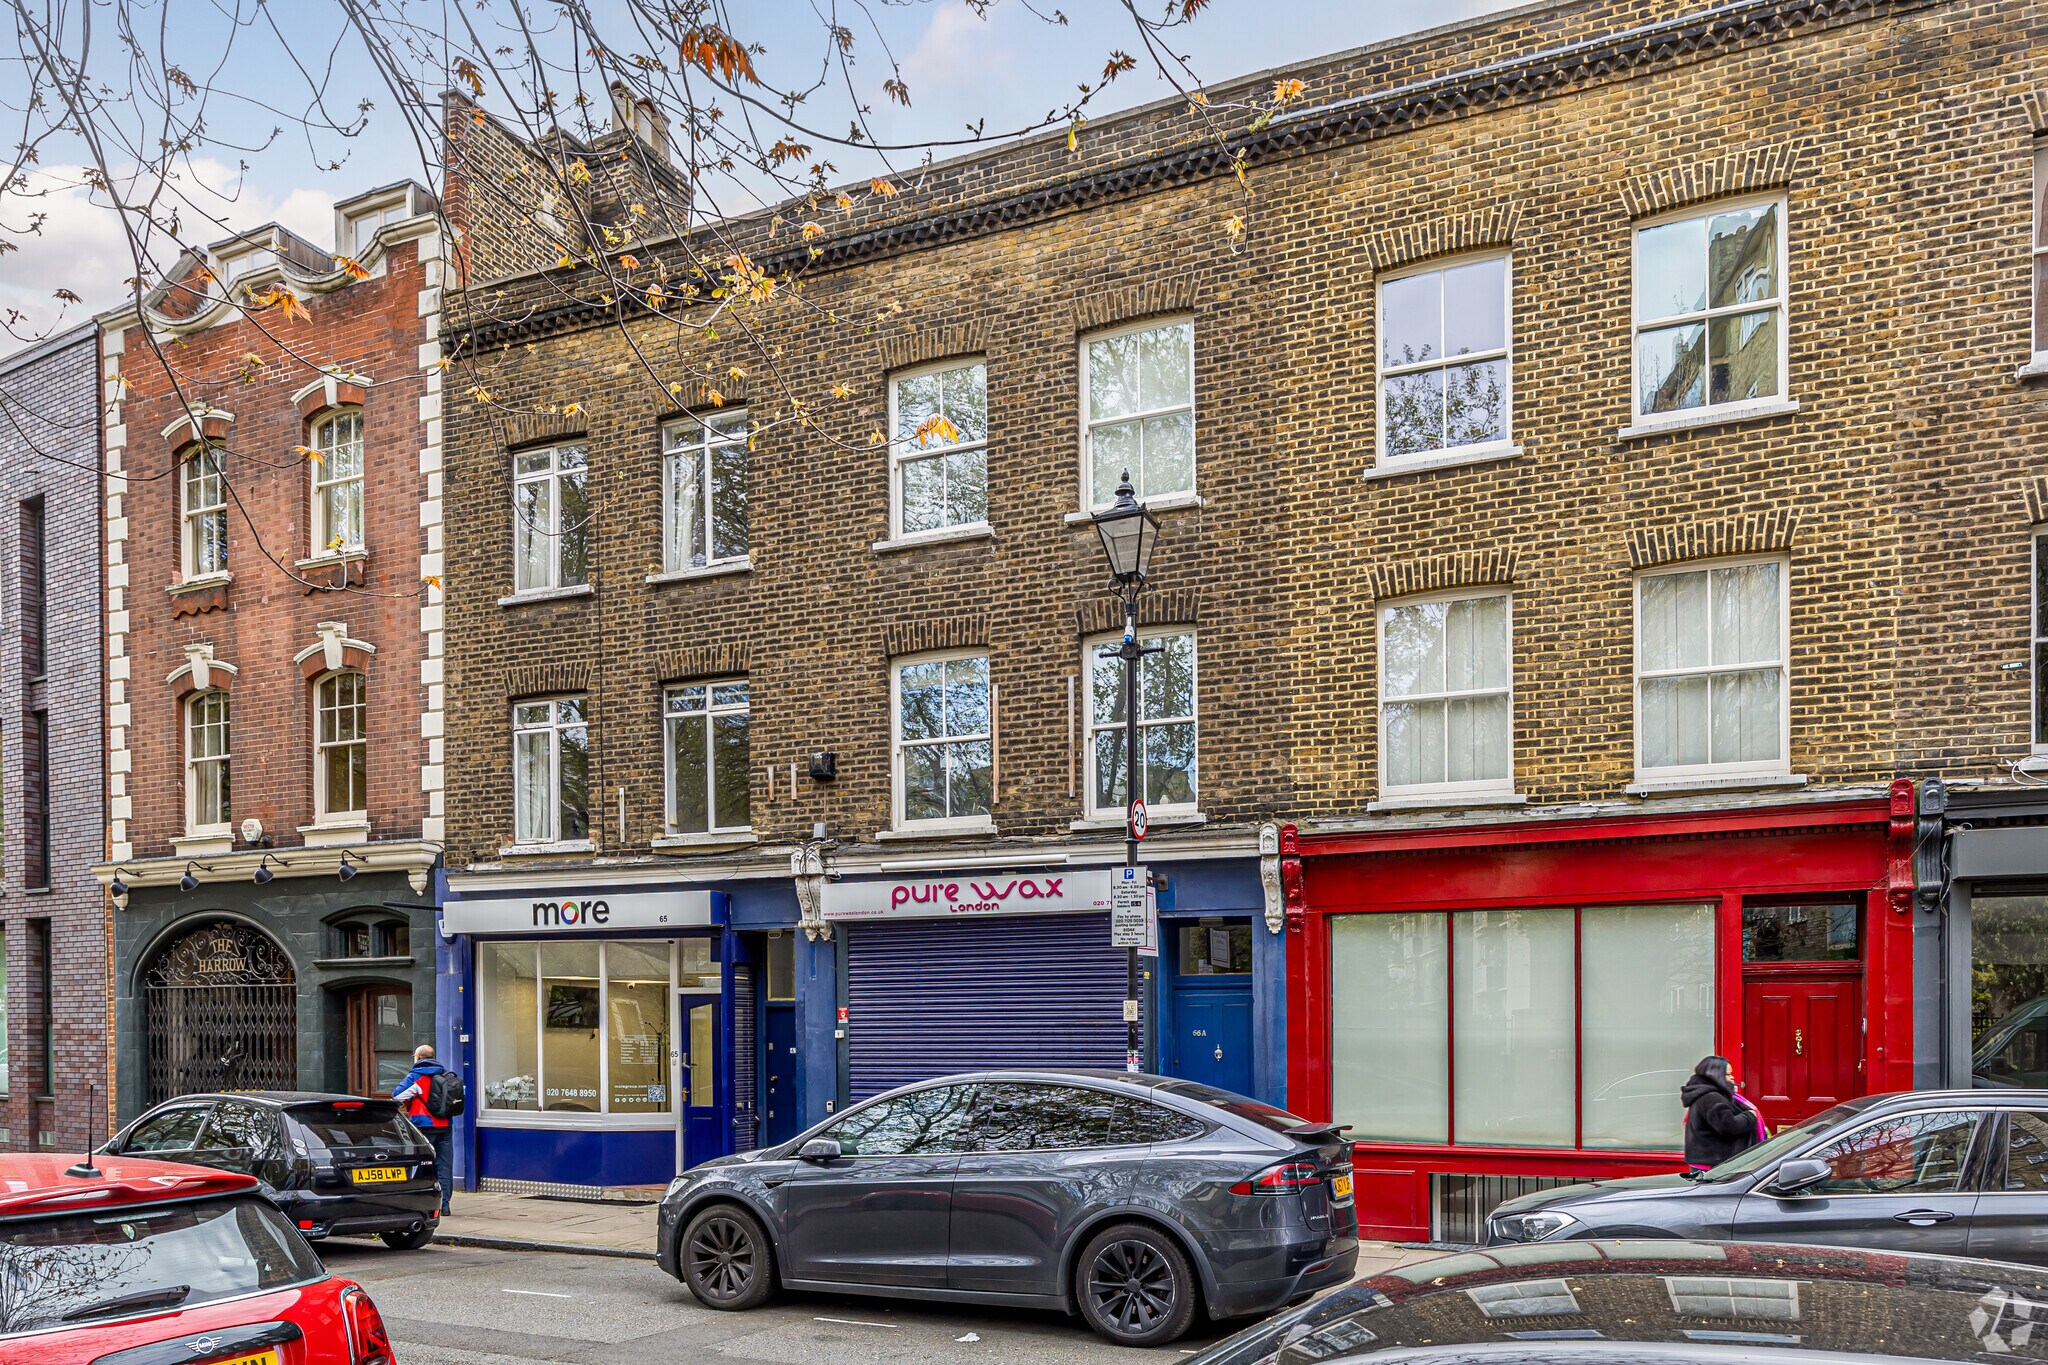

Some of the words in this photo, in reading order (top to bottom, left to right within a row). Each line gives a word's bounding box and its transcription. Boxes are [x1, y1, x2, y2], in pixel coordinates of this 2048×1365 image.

[1135, 810, 1144, 829] 20
[1126, 870, 1132, 878] P
[891, 884, 959, 910] pure
[970, 878, 1063, 899] wax
[532, 900, 610, 926] more
[950, 902, 999, 913] London
[210, 938, 233, 953] THE
[200, 957, 246, 972] HARROW
[580, 1089, 597, 1097] 8950
[358, 1170, 383, 1180] AJ58
[386, 1169, 401, 1179] LWP
